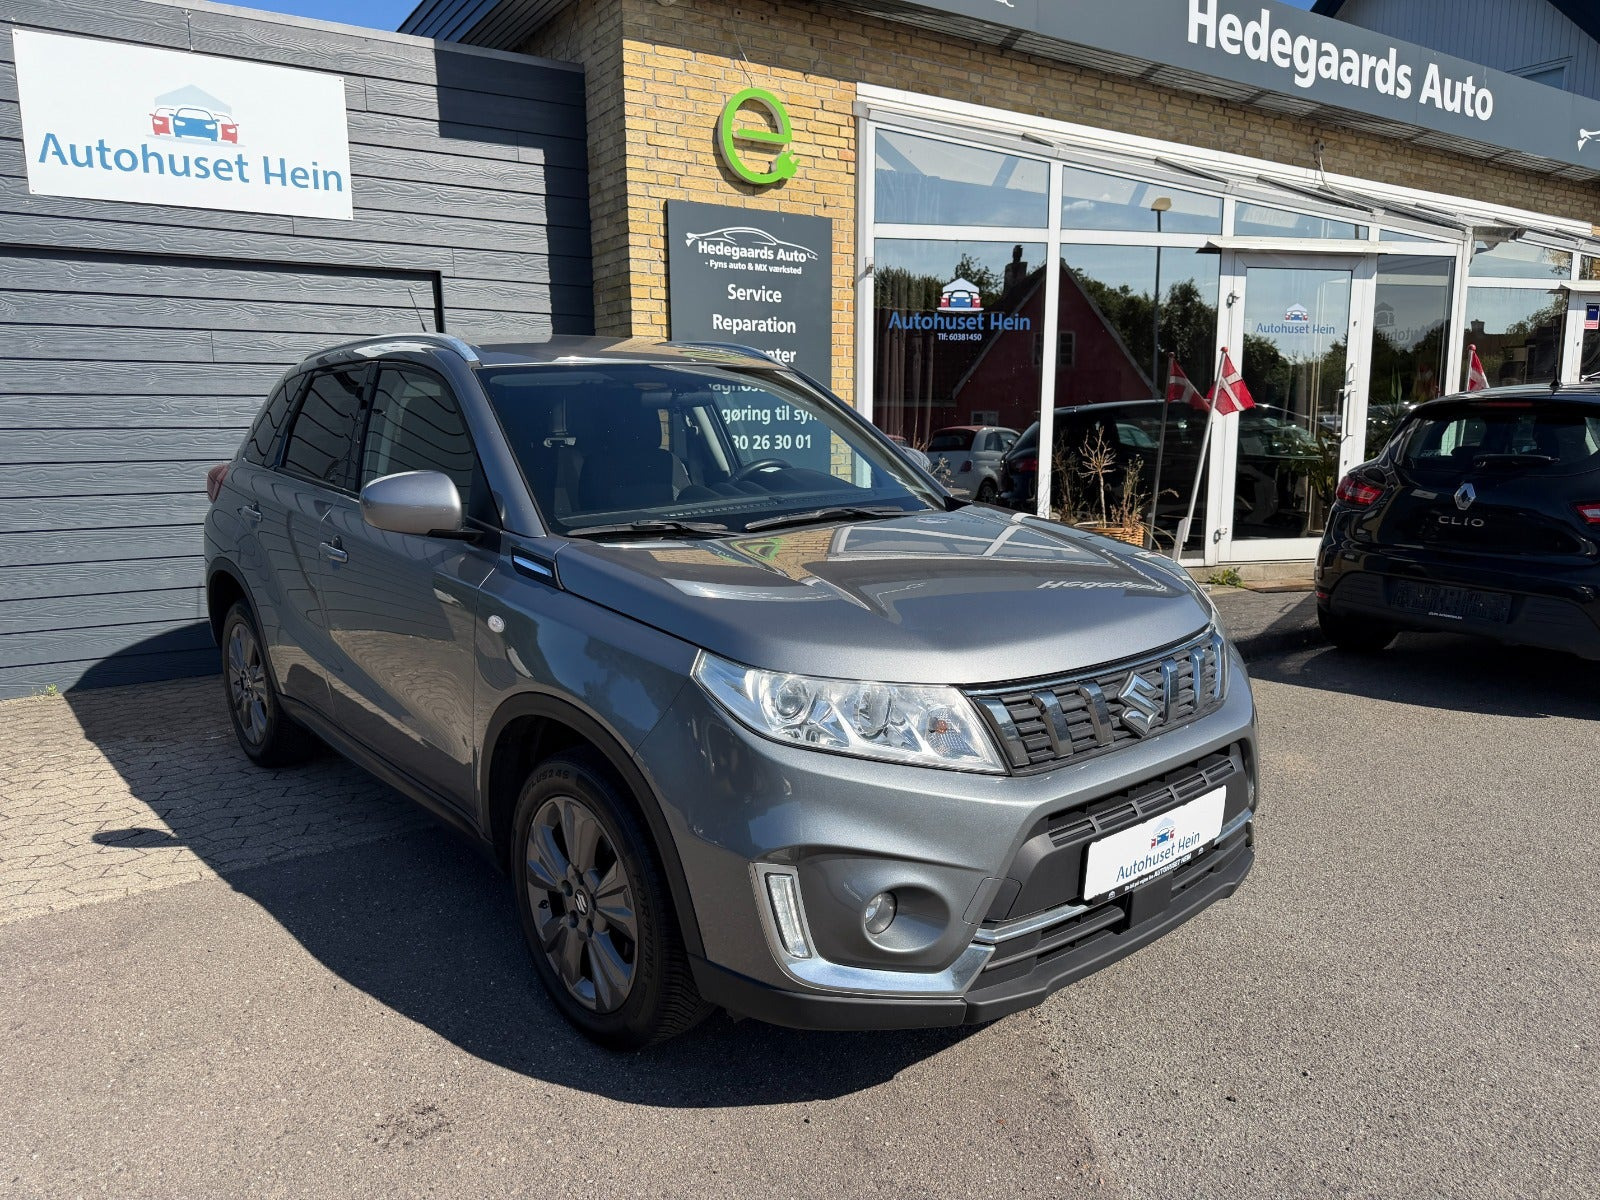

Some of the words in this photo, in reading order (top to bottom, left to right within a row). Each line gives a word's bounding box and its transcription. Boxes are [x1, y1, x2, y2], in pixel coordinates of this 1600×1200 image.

[1187, 0, 1412, 100] Hedegaards
[1419, 63, 1494, 121] Auto
[38, 132, 250, 184] Autohuset
[262, 155, 343, 192] Hein
[698, 240, 774, 260] Hedegaards
[777, 248, 807, 263] Auto
[709, 259, 728, 270] Fyns
[729, 261, 747, 271] auto
[748, 262, 754, 270] &
[755, 263, 768, 272] MX
[769, 265, 802, 275] værksted
[727, 283, 782, 303] Service
[712, 313, 797, 335] Reparation
[888, 311, 984, 332] Autohuset
[990, 312, 1031, 331] Hein
[1256, 322, 1310, 335] Autohuset
[1312, 324, 1336, 335] Hein
[948, 332, 982, 342] 60381450
[766, 348, 797, 363] nter
[721, 404, 771, 425] gøring
[775, 404, 790, 421] til
[752, 434, 771, 450] 26
[774, 434, 792, 450] 30
[795, 433, 812, 449] 01
[1437, 514, 1486, 528] CLIO
[1115, 843, 1176, 883] Autohuset
[1177, 831, 1200, 854] Hein
